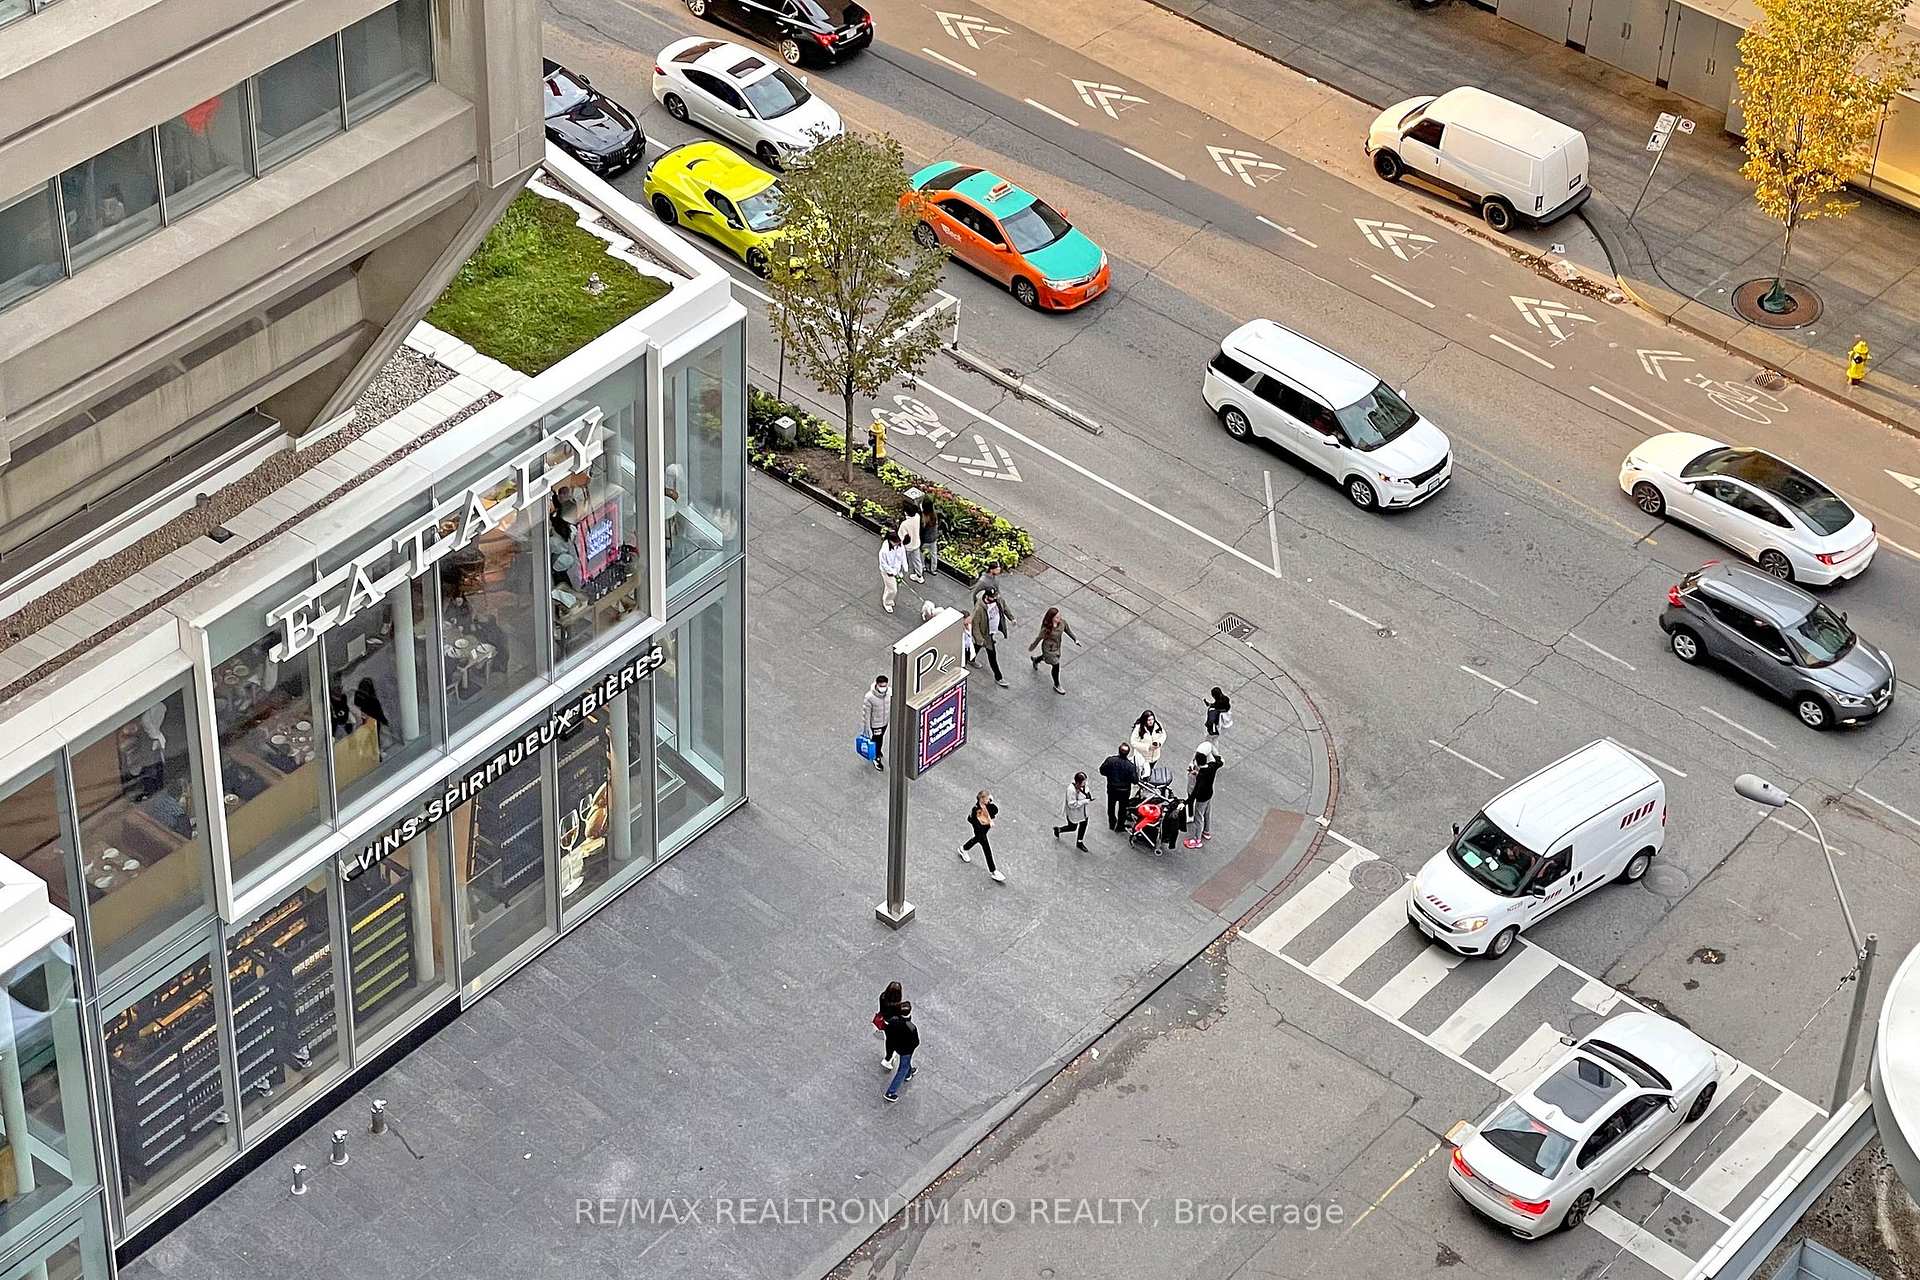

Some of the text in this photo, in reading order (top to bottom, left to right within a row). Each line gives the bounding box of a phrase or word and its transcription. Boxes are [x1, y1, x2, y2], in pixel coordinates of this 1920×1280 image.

[266, 406, 604, 663] EATALY
[357, 646, 664, 870] VINS SPIRITUEUX BIÈRES
[914, 647, 939, 695] P
